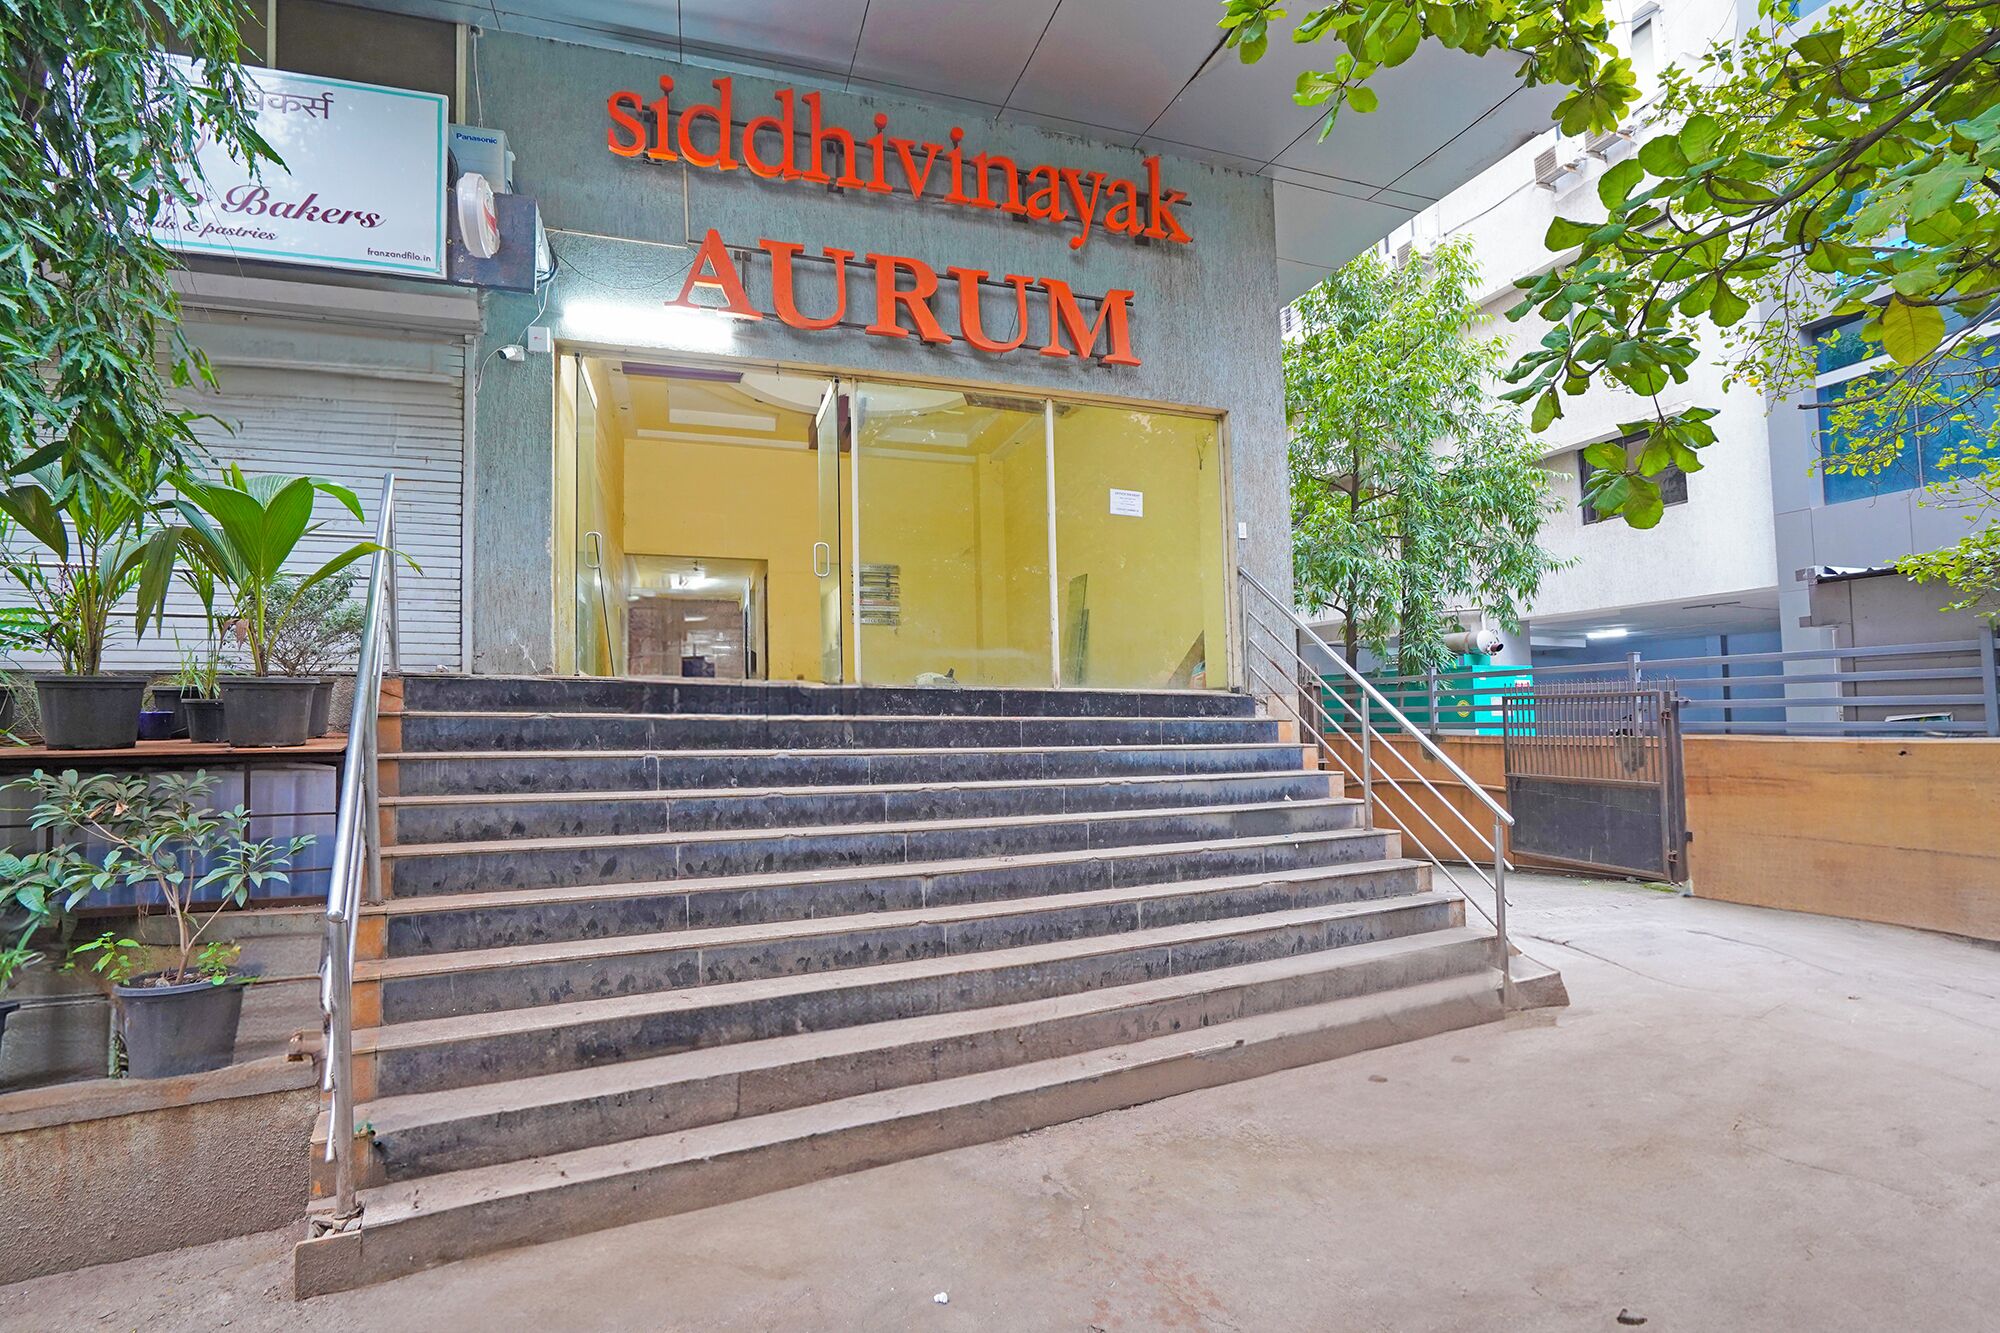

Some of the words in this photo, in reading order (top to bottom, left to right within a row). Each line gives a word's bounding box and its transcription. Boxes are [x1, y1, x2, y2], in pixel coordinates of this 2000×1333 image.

[456, 132, 498, 144] Panasonic
[606, 74, 1193, 250] siddhivinayak
[220, 184, 387, 229] Bakers
[366, 247, 432, 263] franzandfilo.in
[664, 228, 1142, 367] AURUM
